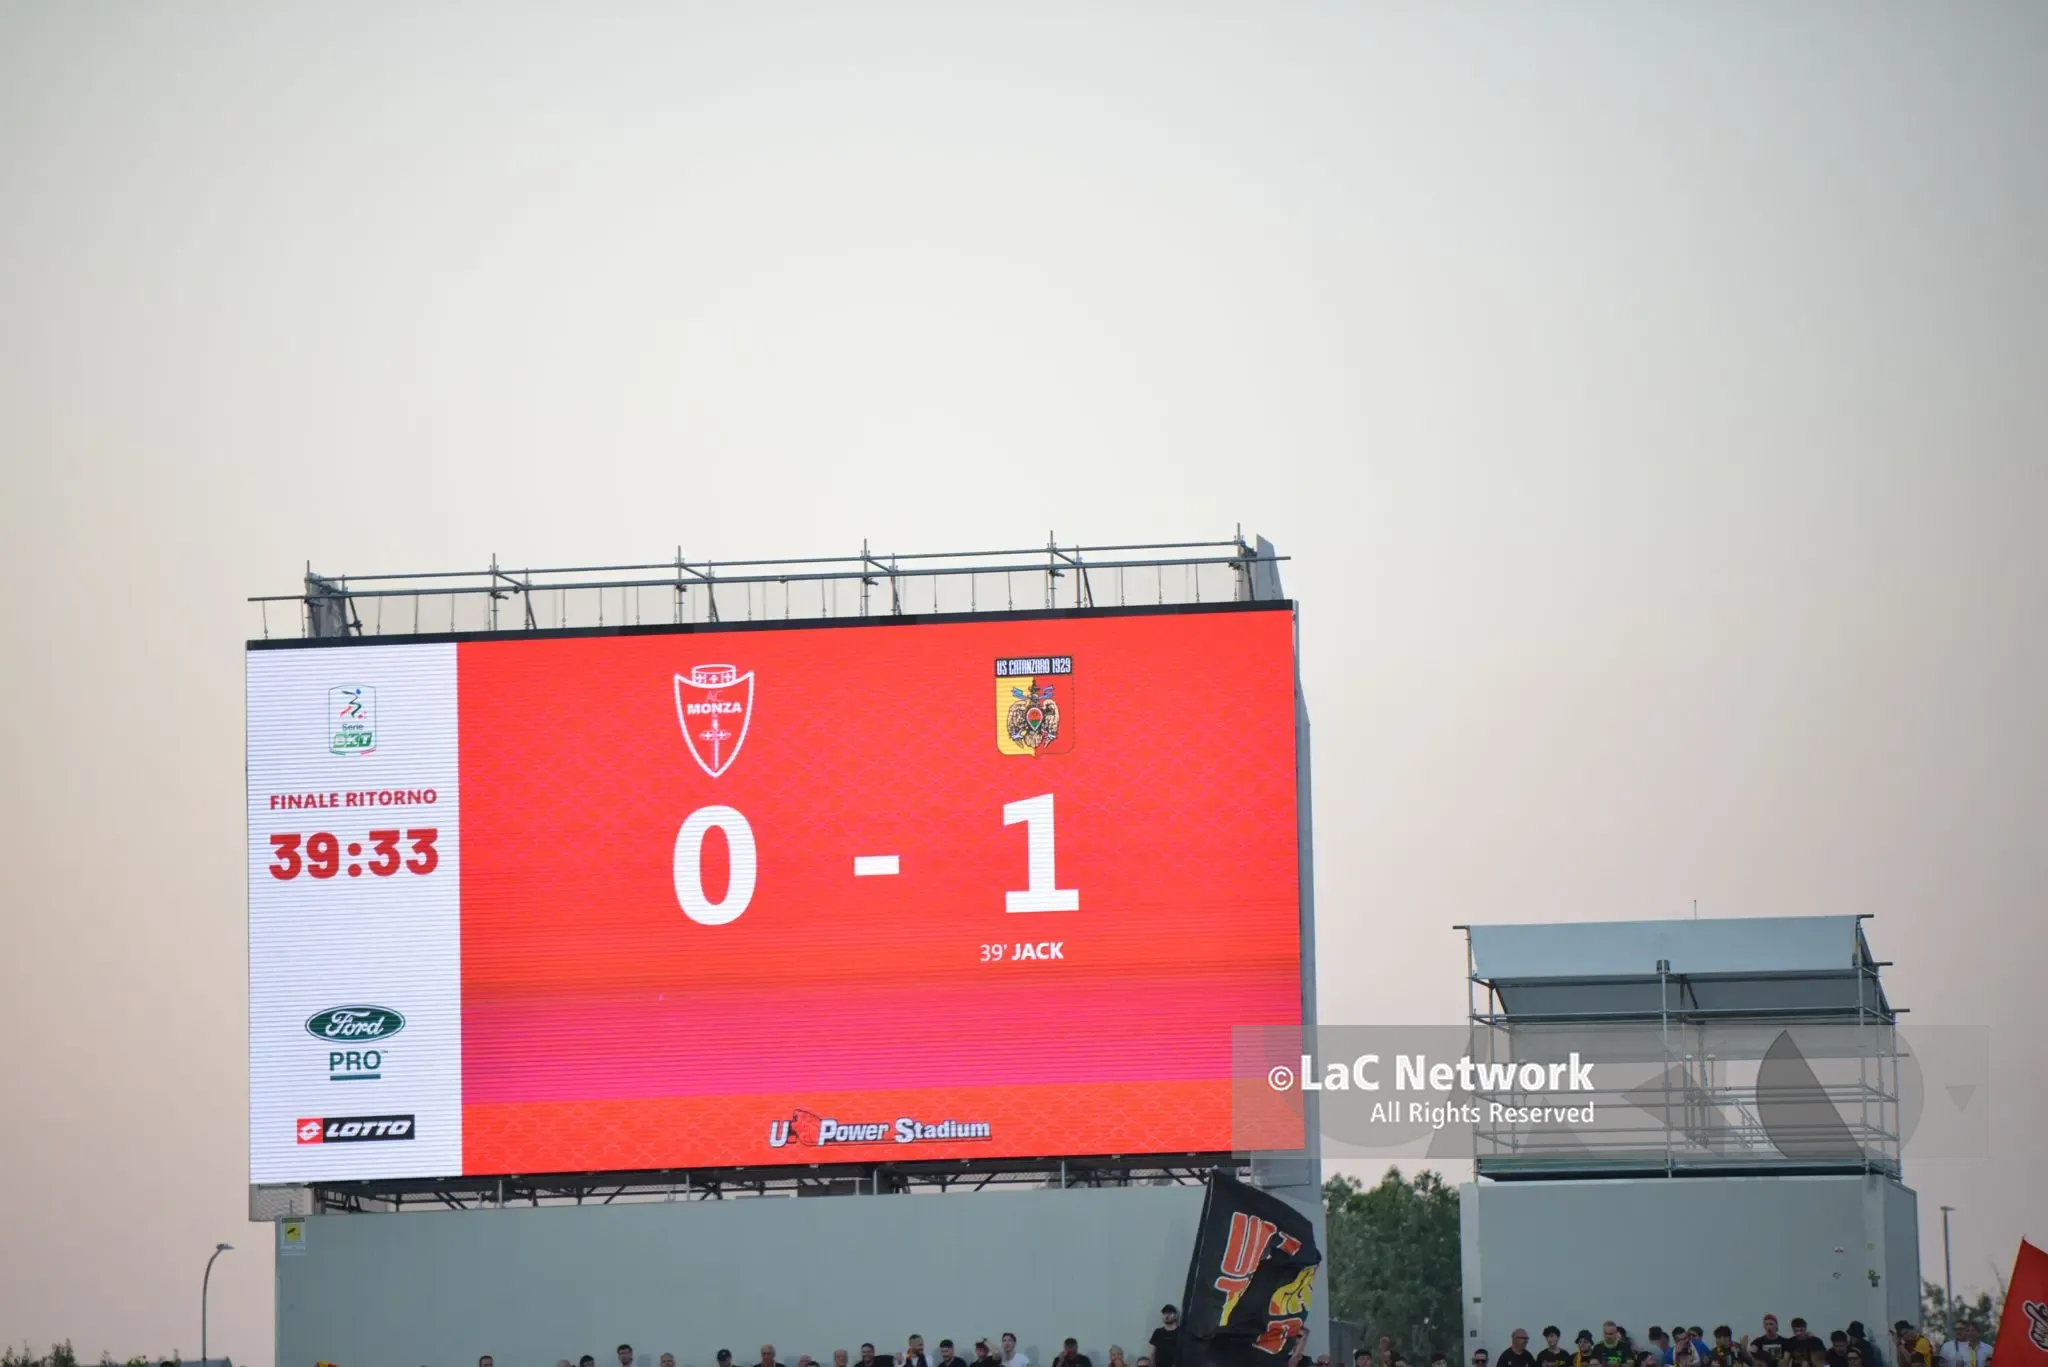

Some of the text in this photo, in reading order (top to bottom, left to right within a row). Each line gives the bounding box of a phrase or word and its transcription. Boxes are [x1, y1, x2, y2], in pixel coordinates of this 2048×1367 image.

[996, 660, 1008, 676] US
[1052, 657, 1071, 673] 1929
[686, 701, 742, 715] MONZA
[269, 789, 438, 810] FINALE RITORNO
[269, 828, 439, 880] 39:33
[673, 804, 758, 926] 0
[1003, 792, 1080, 914] 1
[1011, 941, 1064, 961] JACK
[325, 1010, 384, 1036] Ford
[329, 1050, 382, 1071] PRO
[326, 1120, 411, 1137] LOTTO
[816, 1117, 891, 1147] Power
[894, 1117, 991, 1144] Stadium
